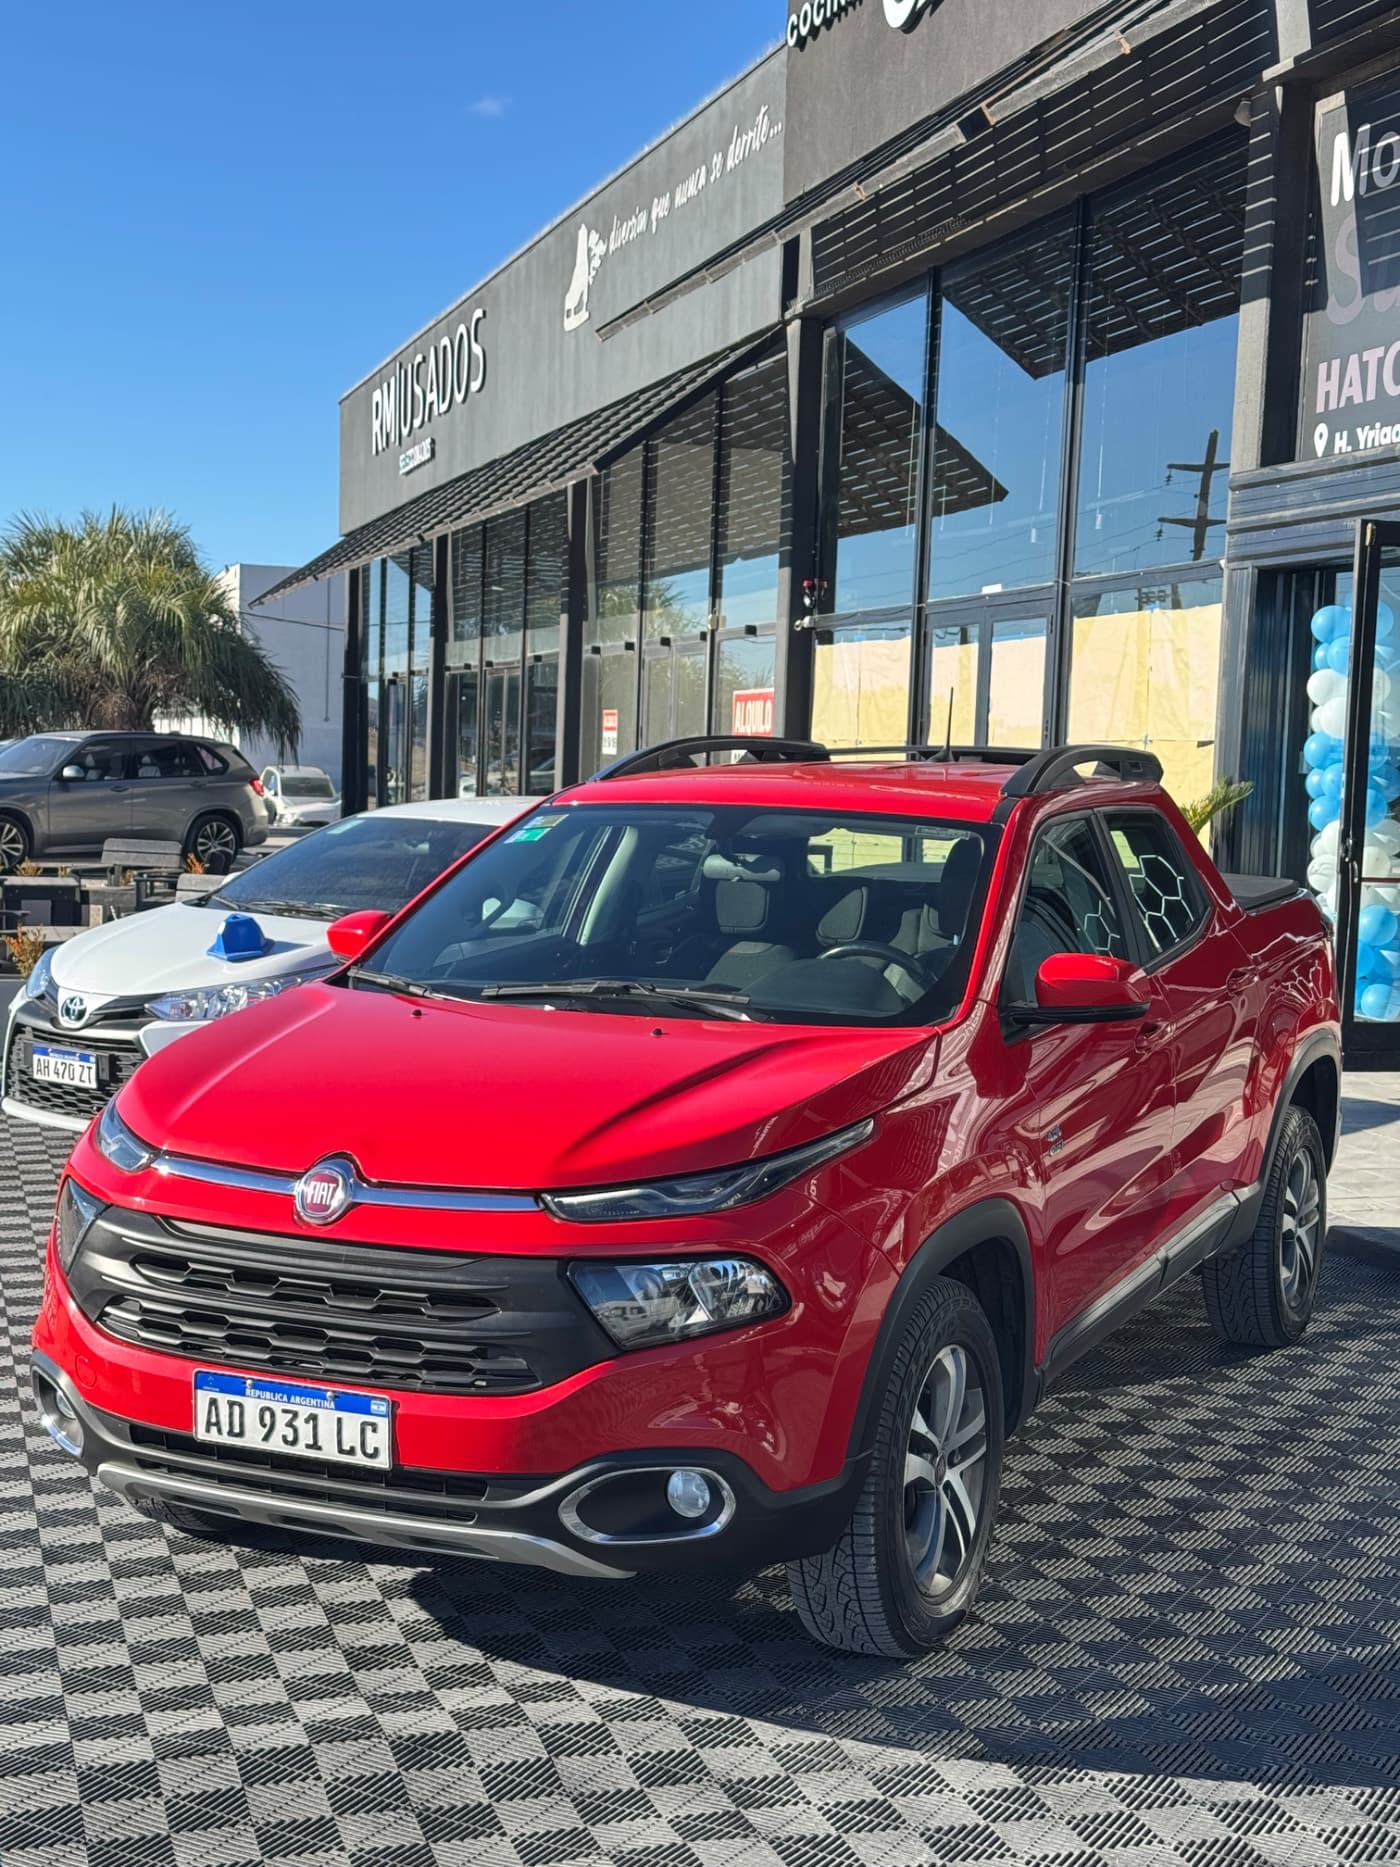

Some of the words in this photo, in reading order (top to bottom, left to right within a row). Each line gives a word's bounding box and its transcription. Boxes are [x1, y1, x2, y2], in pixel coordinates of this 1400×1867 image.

[651, 192, 670, 234] que
[675, 165, 706, 208] nunca
[710, 152, 723, 183] se
[1334, 430, 1352, 454] H.
[736, 699, 772, 736] ALQUILO
[36, 1058, 49, 1077] AH
[54, 1061, 75, 1081] 470
[79, 1064, 92, 1084] ZT
[306, 1181, 337, 1205] FIAT
[290, 1396, 335, 1409] ARGENTINA
[205, 1397, 245, 1439] AD
[258, 1405, 322, 1451] 931
[336, 1416, 379, 1459] LC
